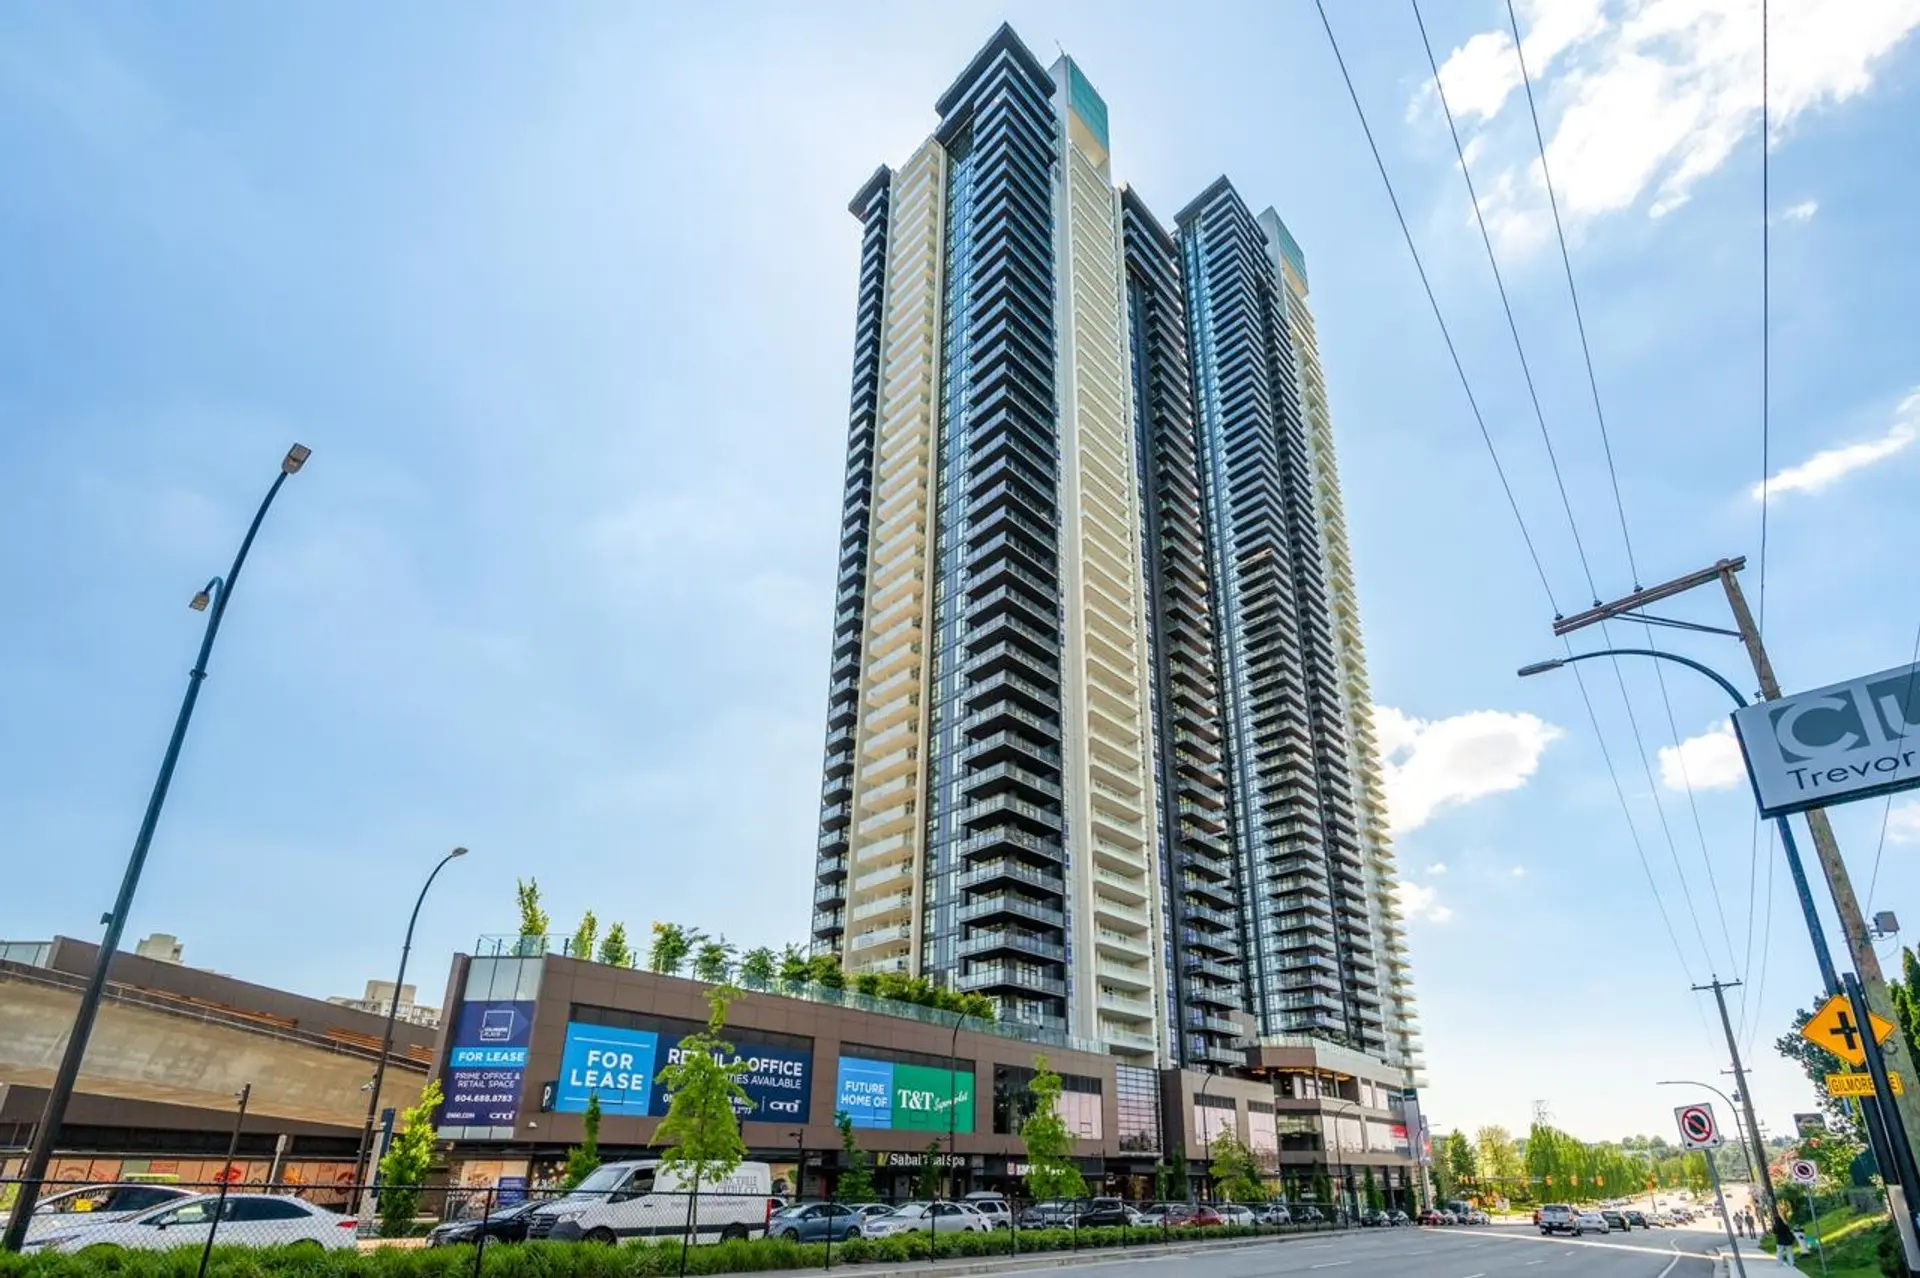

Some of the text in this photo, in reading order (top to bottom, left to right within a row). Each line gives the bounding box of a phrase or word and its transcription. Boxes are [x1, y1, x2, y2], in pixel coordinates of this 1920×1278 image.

[1786, 750, 1916, 790] Trevor
[458, 1052, 525, 1062] FOR LEASE
[587, 1050, 634, 1070] FOR
[747, 1057, 803, 1077] OFFICE
[455, 1072, 480, 1080] PRIME
[481, 1072, 513, 1080] OFFICE
[570, 1069, 643, 1091] LEASE
[749, 1074, 802, 1090] AVAILABLE
[457, 1080, 515, 1089] RETAIL SPACE
[845, 1080, 885, 1095] FUTURE
[1831, 1076, 1874, 1093] GILMORE
[840, 1094, 888, 1108] HOME OF
[897, 1088, 935, 1111] T&T
[890, 1153, 921, 1167] Sabai
[946, 1155, 966, 1169] Spa
